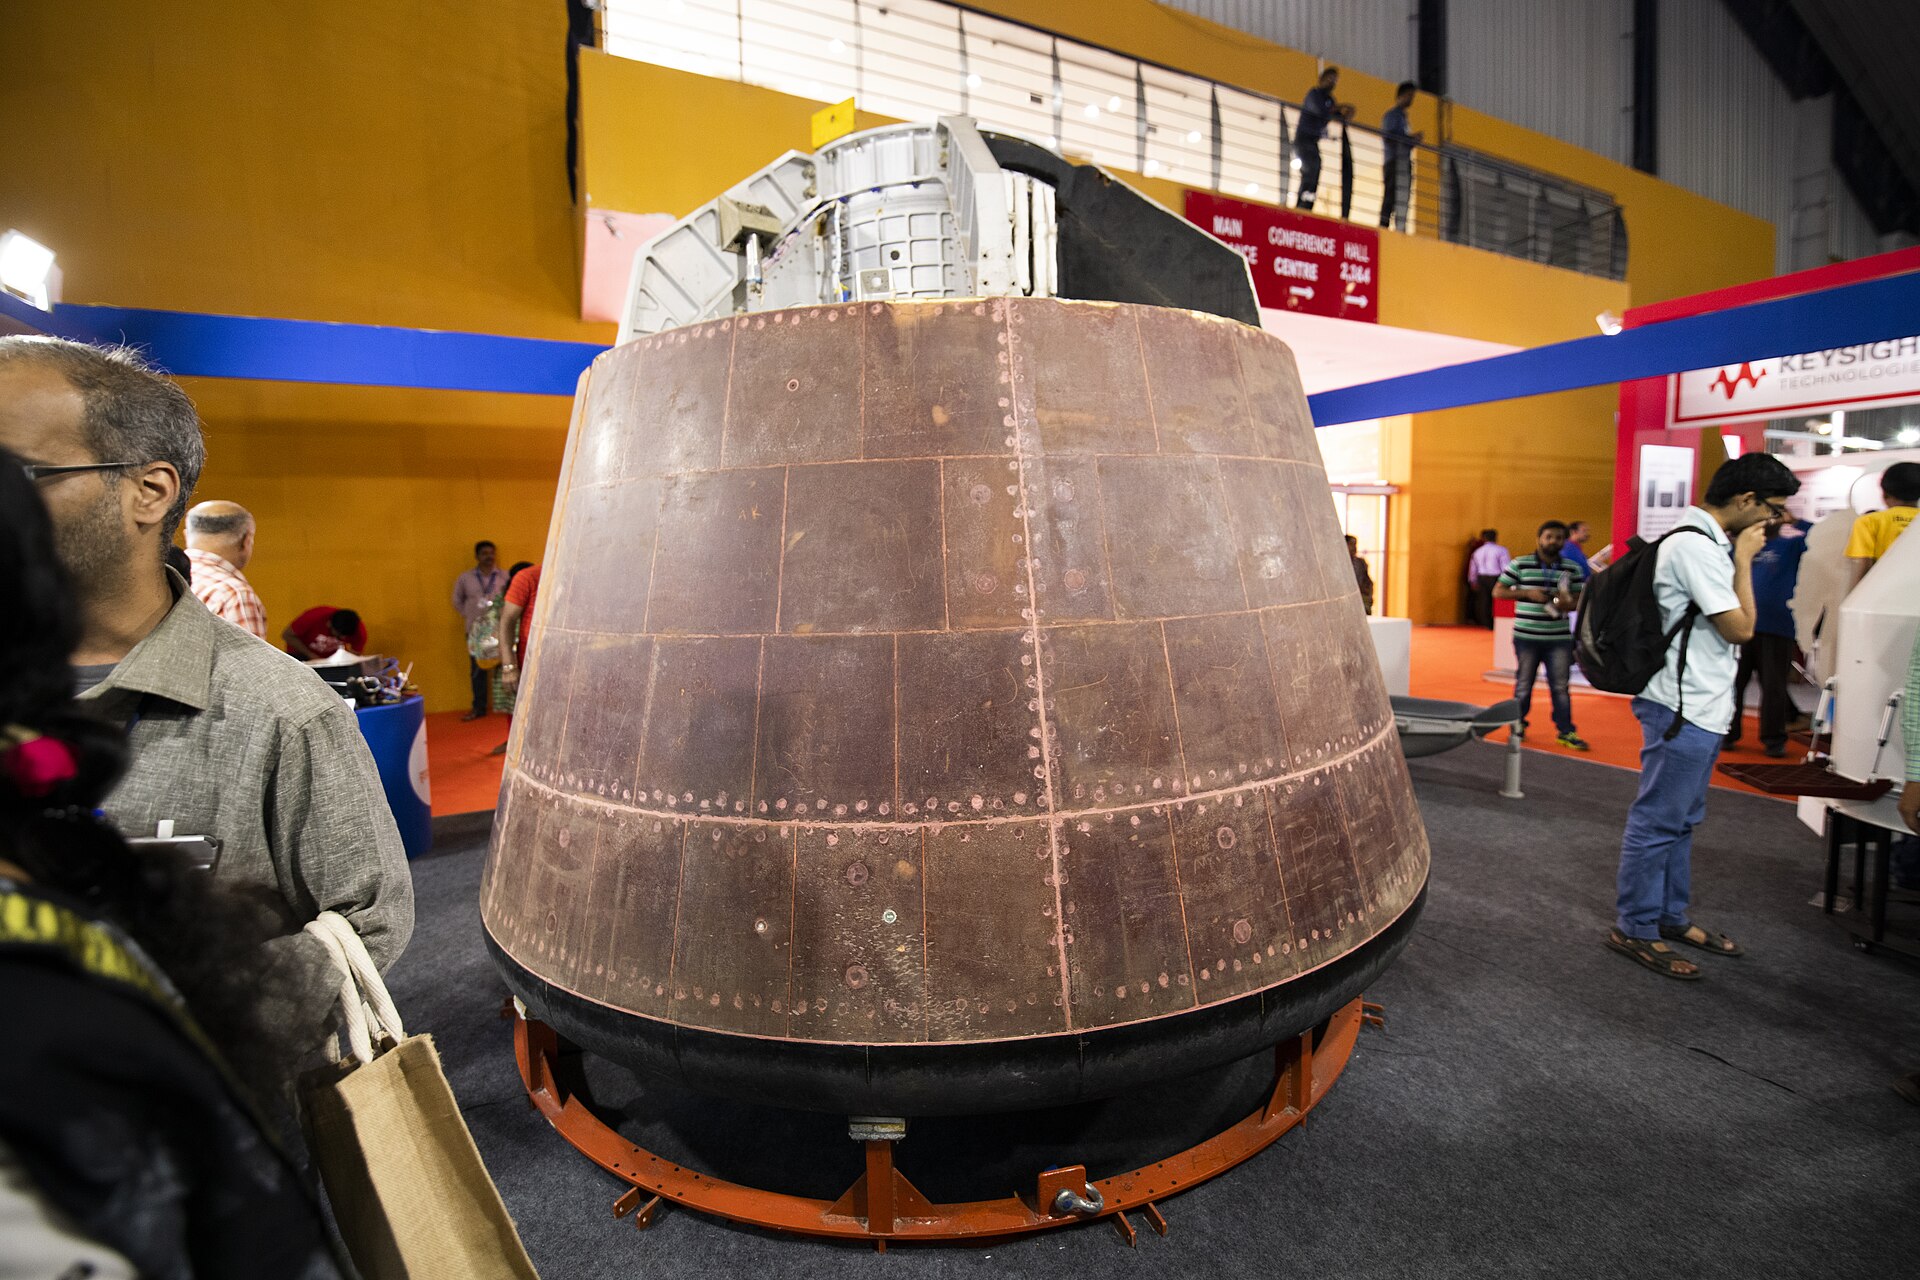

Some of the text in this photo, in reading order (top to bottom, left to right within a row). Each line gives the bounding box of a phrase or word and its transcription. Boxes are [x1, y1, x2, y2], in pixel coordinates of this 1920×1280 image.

[1213, 215, 1243, 238] MAIN
[1268, 226, 1336, 257] CONFERENCE
[1344, 241, 1369, 263] HALL
[1274, 257, 1319, 281] CENTRE
